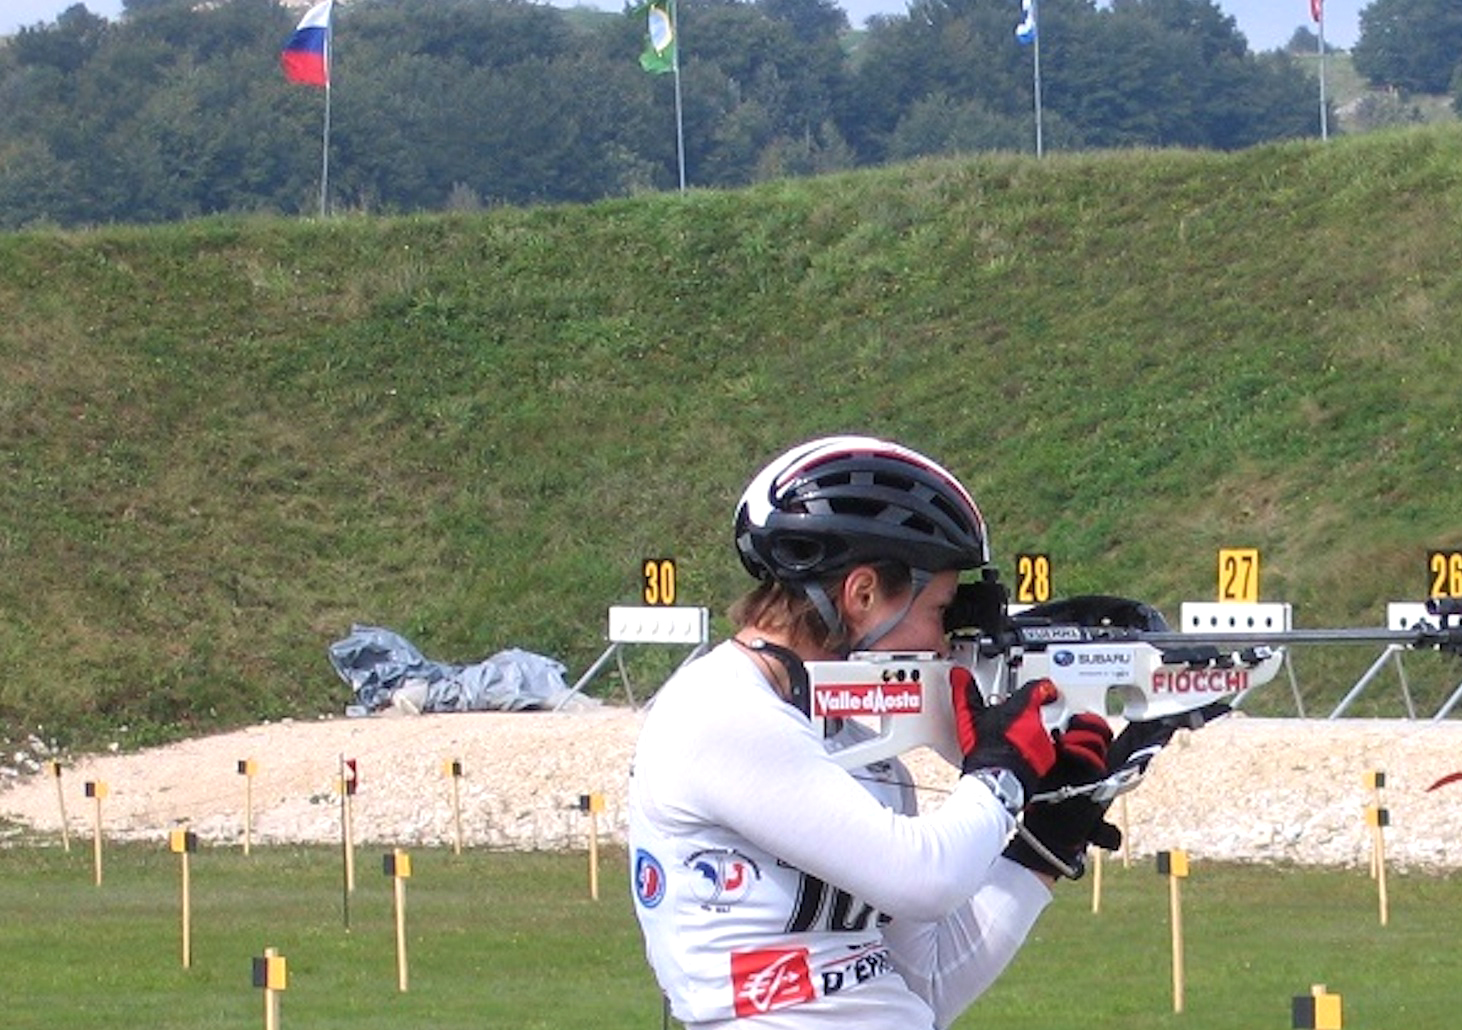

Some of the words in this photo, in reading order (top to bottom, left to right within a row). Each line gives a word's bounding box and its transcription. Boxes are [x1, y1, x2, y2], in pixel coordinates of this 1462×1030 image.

[645, 561, 675, 605] 30
[1018, 556, 1049, 603] 28
[1223, 555, 1253, 600] 27
[1078, 653, 1132, 665] SUBARU
[1152, 669, 1249, 694] FIOCCHI
